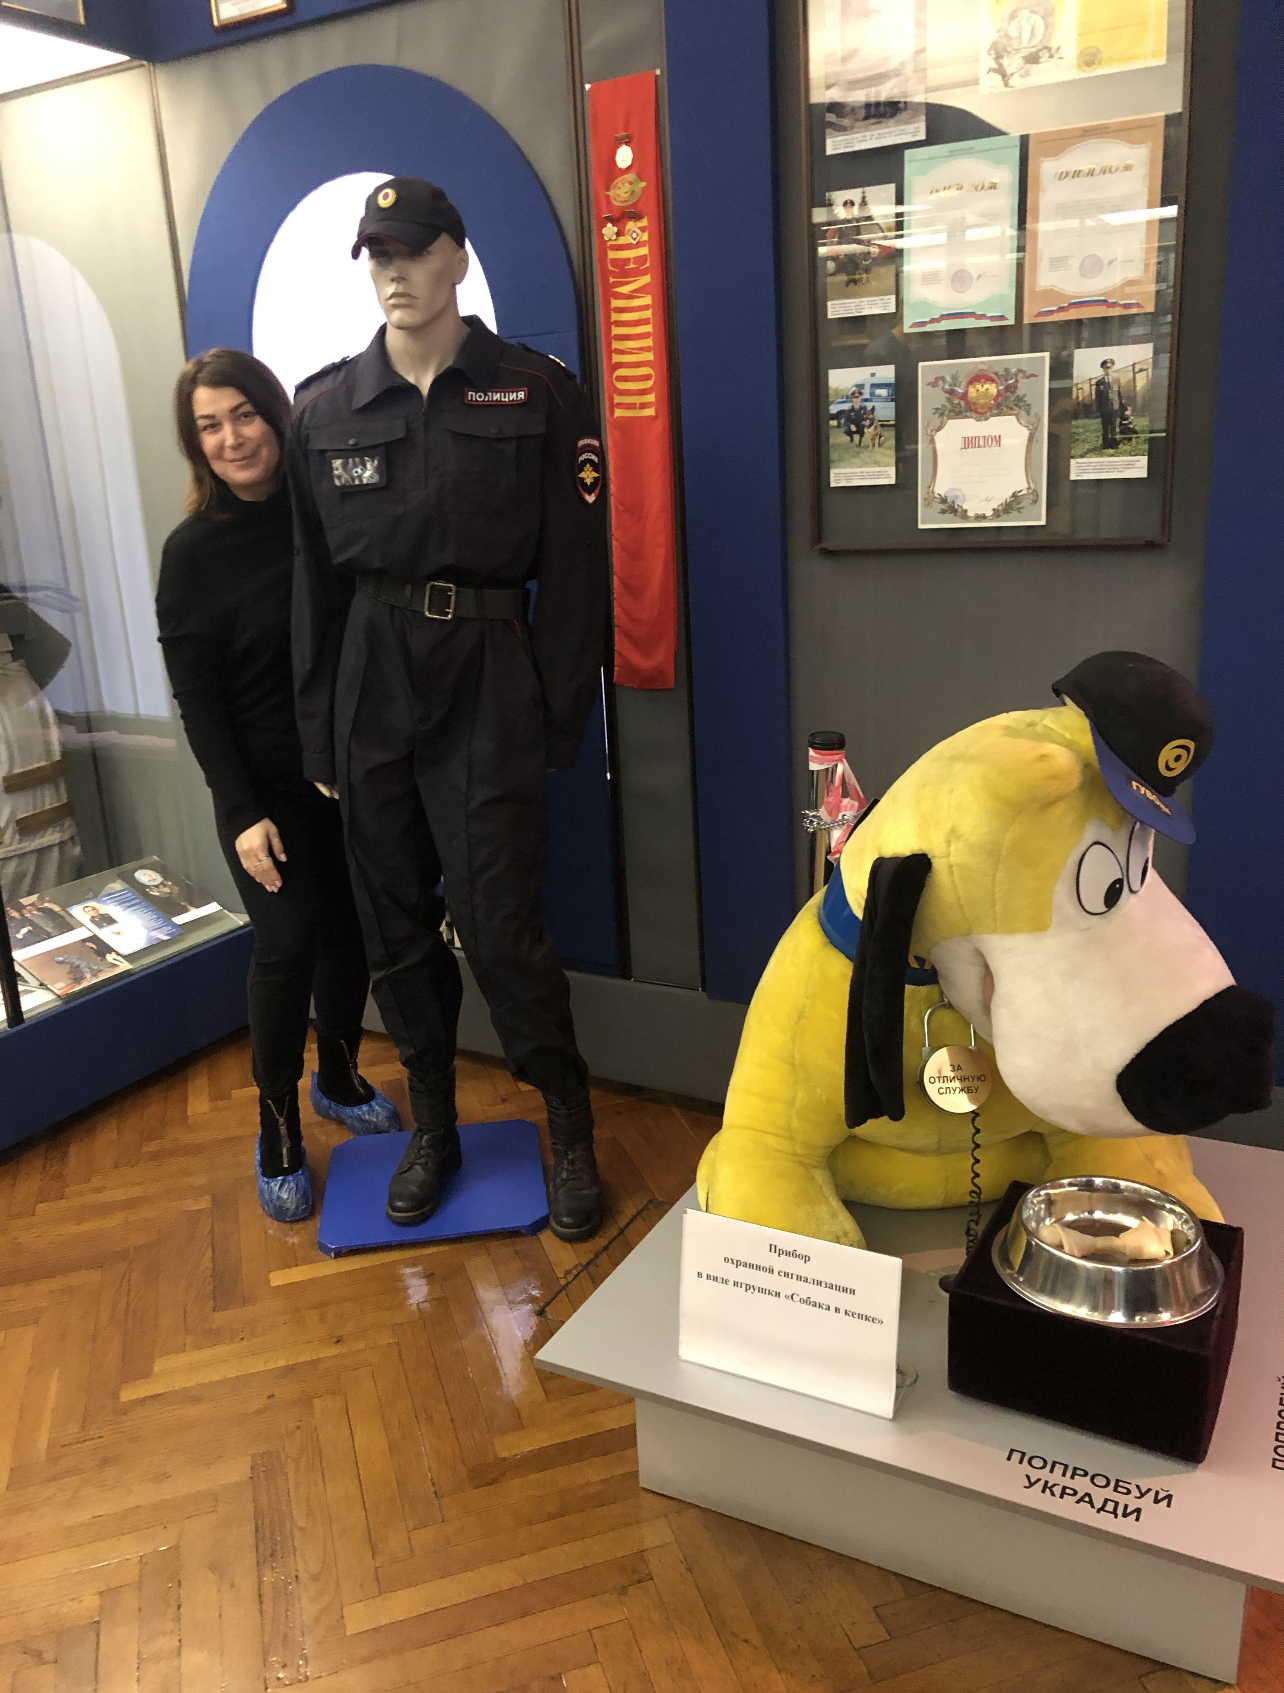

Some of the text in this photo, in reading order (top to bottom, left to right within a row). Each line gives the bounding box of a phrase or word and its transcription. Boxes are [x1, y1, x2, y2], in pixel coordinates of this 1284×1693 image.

[467, 390, 525, 402] ПОЛИЦИЯ
[960, 434, 1002, 450] ДИПЛОМ
[950, 1064, 963, 1072] ЗА
[929, 1074, 987, 1084] ОТЛИЧНУЮ
[938, 1086, 979, 1095] СЛУЖБУ
[768, 1243, 811, 1264] Прибор
[723, 1255, 856, 1296] охранной сигнализации
[696, 1271, 884, 1326] в виде игрушки «Собака в кепке»
[1006, 1448, 1174, 1508] ПОПРОБУЙ
[1023, 1474, 1143, 1522] УКРАДИ
